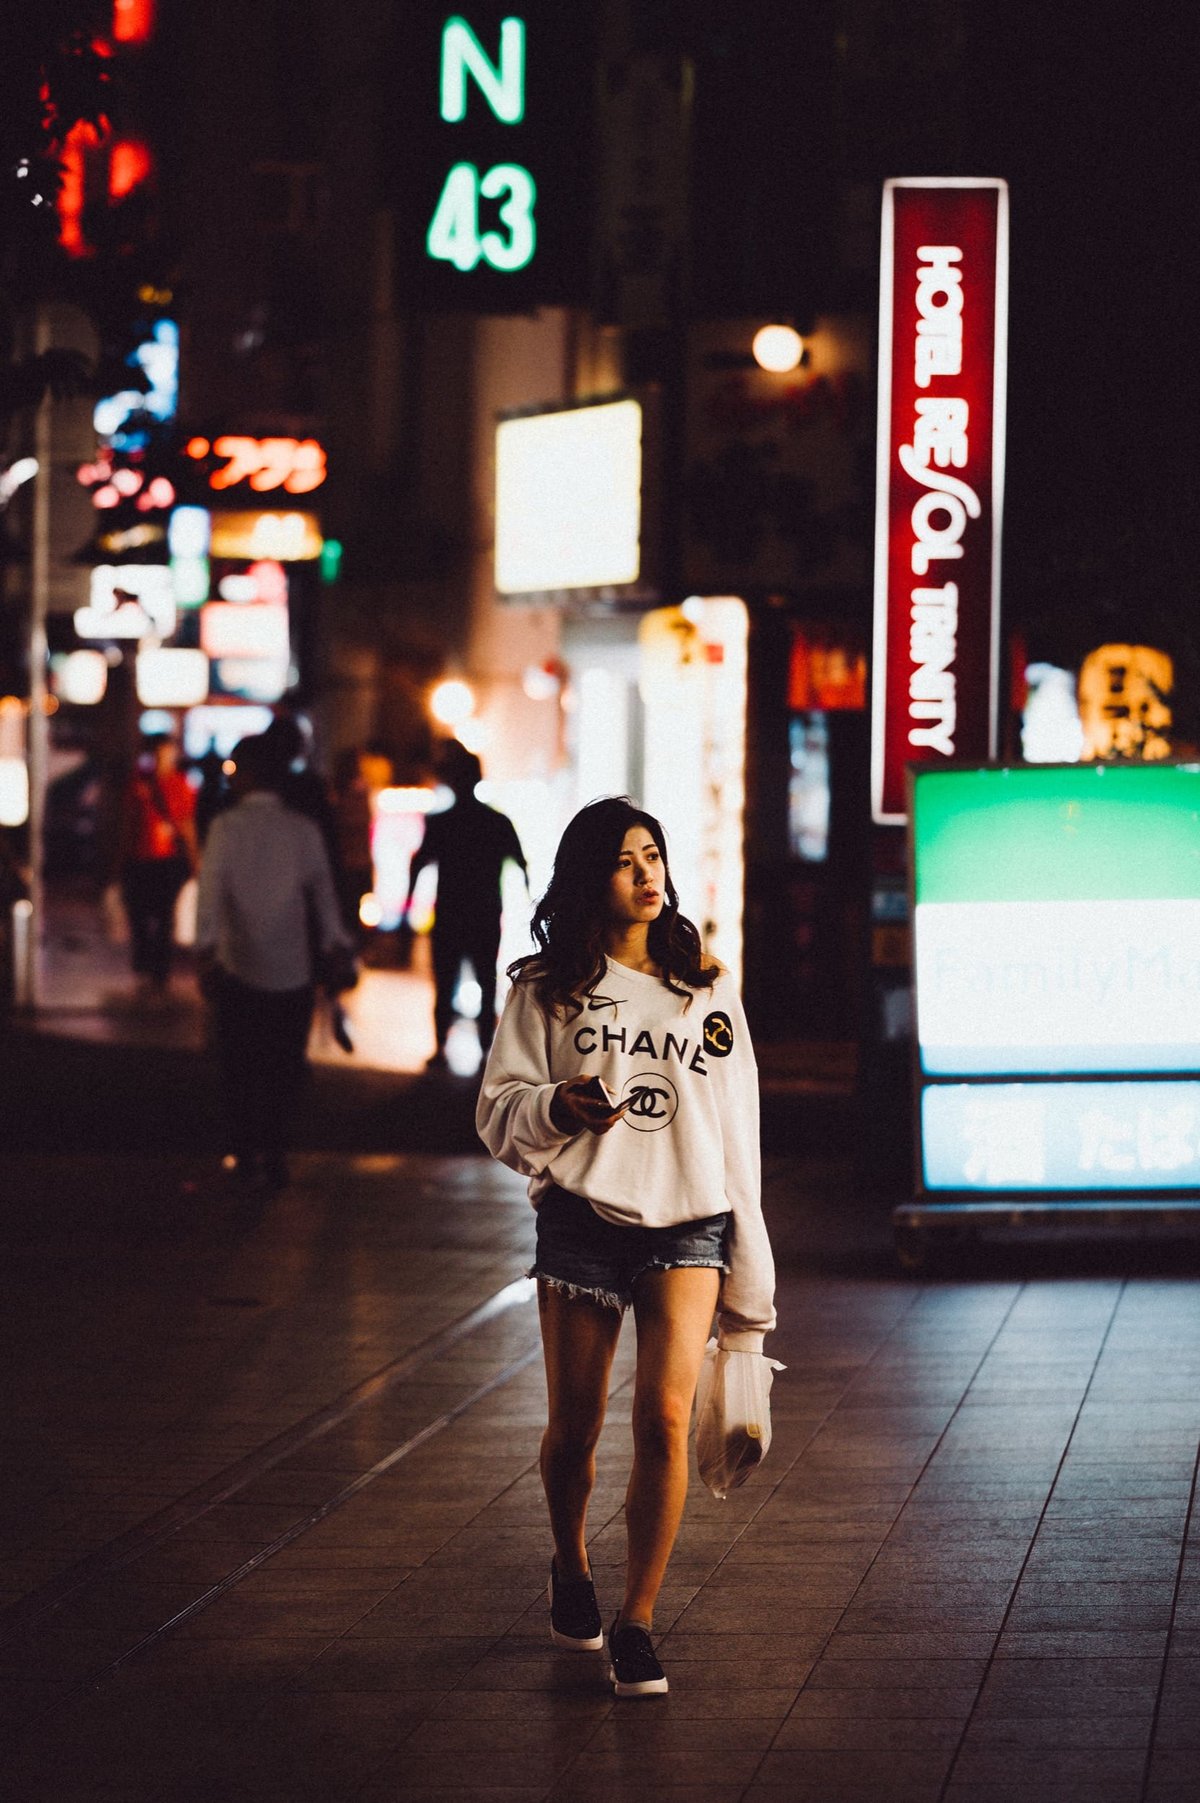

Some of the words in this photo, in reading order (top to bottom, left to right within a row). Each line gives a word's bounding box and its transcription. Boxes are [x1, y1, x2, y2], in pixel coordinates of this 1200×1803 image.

[440, 16, 525, 124] N
[427, 162, 536, 272] 43
[915, 245, 963, 388] HOTEL
[899, 397, 981, 575] RESOL
[908, 581, 958, 755] TRINITY
[1078, 1103, 1200, 1171] たば
